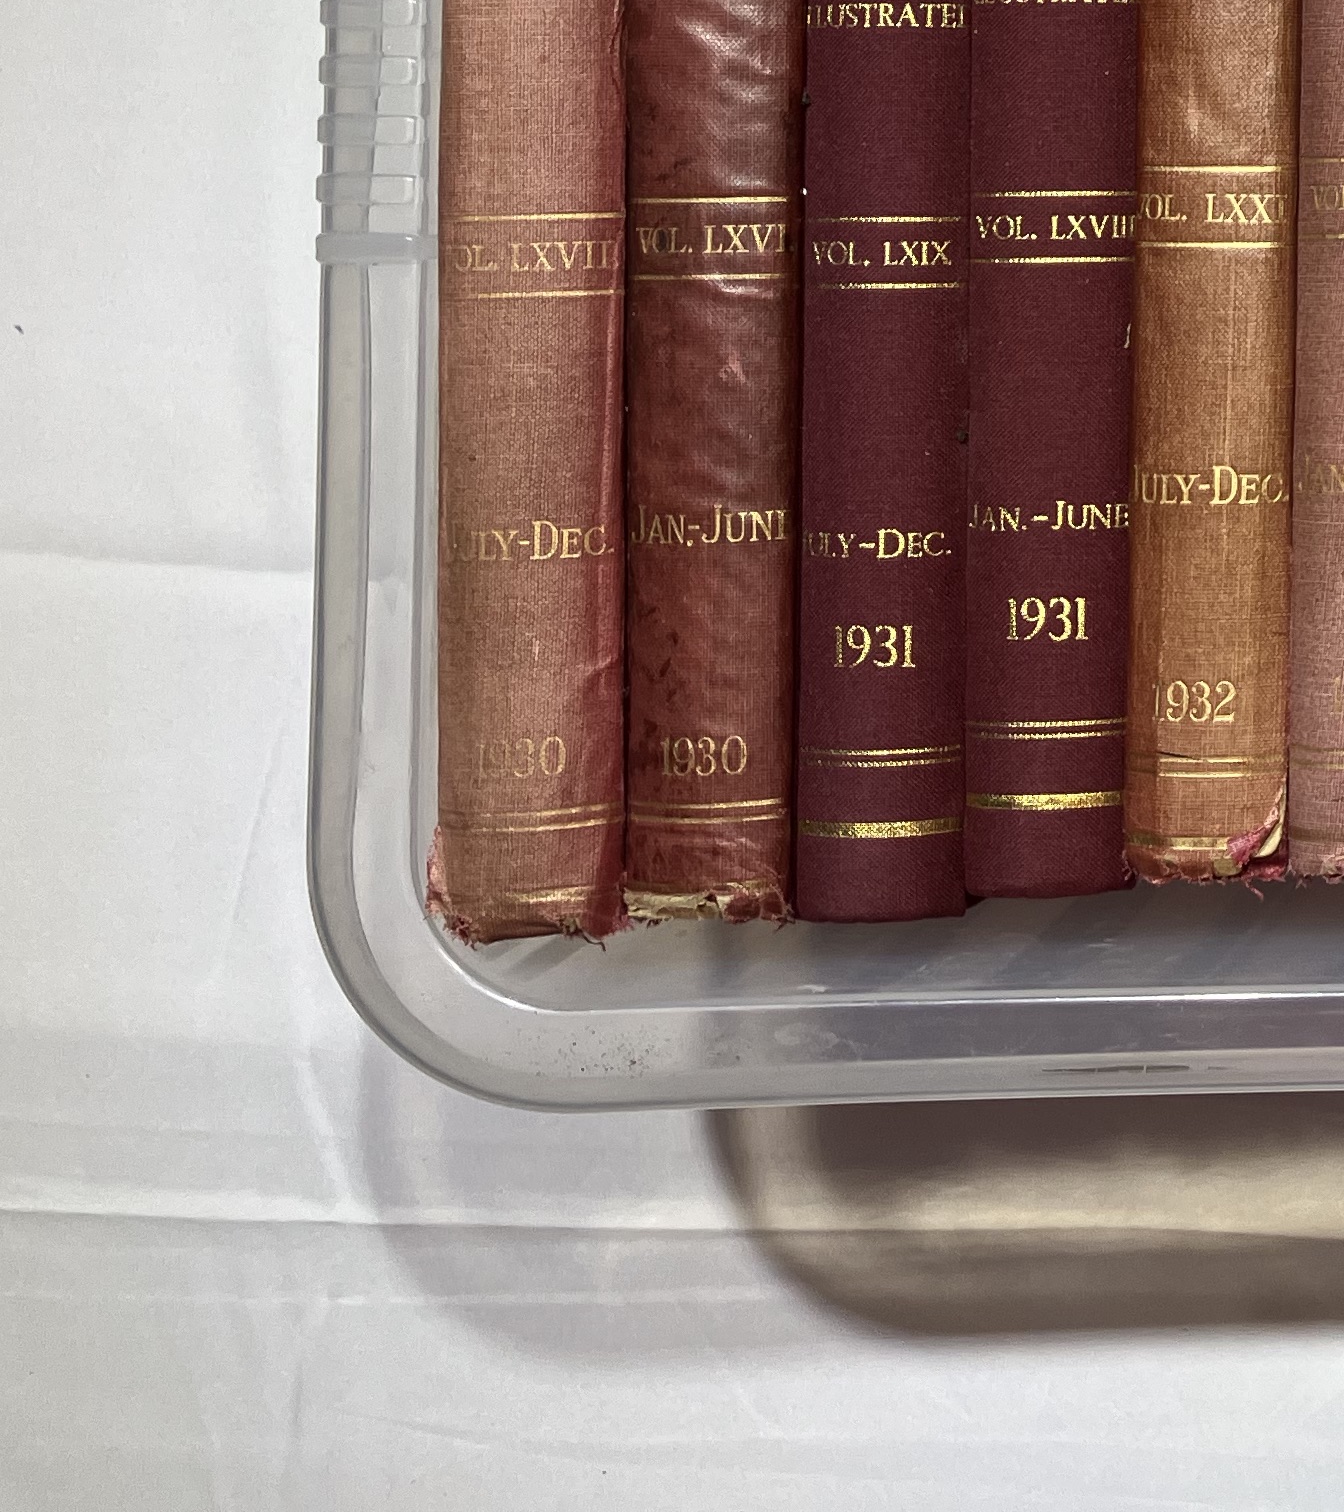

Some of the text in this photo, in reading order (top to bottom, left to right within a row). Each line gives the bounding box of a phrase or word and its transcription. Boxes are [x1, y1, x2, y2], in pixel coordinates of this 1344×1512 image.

[975, 214, 1136, 241] VOL. LXVIII
[1139, 193, 1188, 222] VOL.
[636, 226, 693, 255] VOL.
[812, 240, 872, 267] VOL.
[968, 500, 1130, 532] JAN.-JUNE
[454, 520, 614, 562] ULY-DEC.
[1006, 596, 1090, 643] 1931
[833, 624, 917, 669] 1931
[1152, 680, 1237, 723] 1932
[476, 736, 567, 779] 1930
[660, 735, 748, 777] 1930
